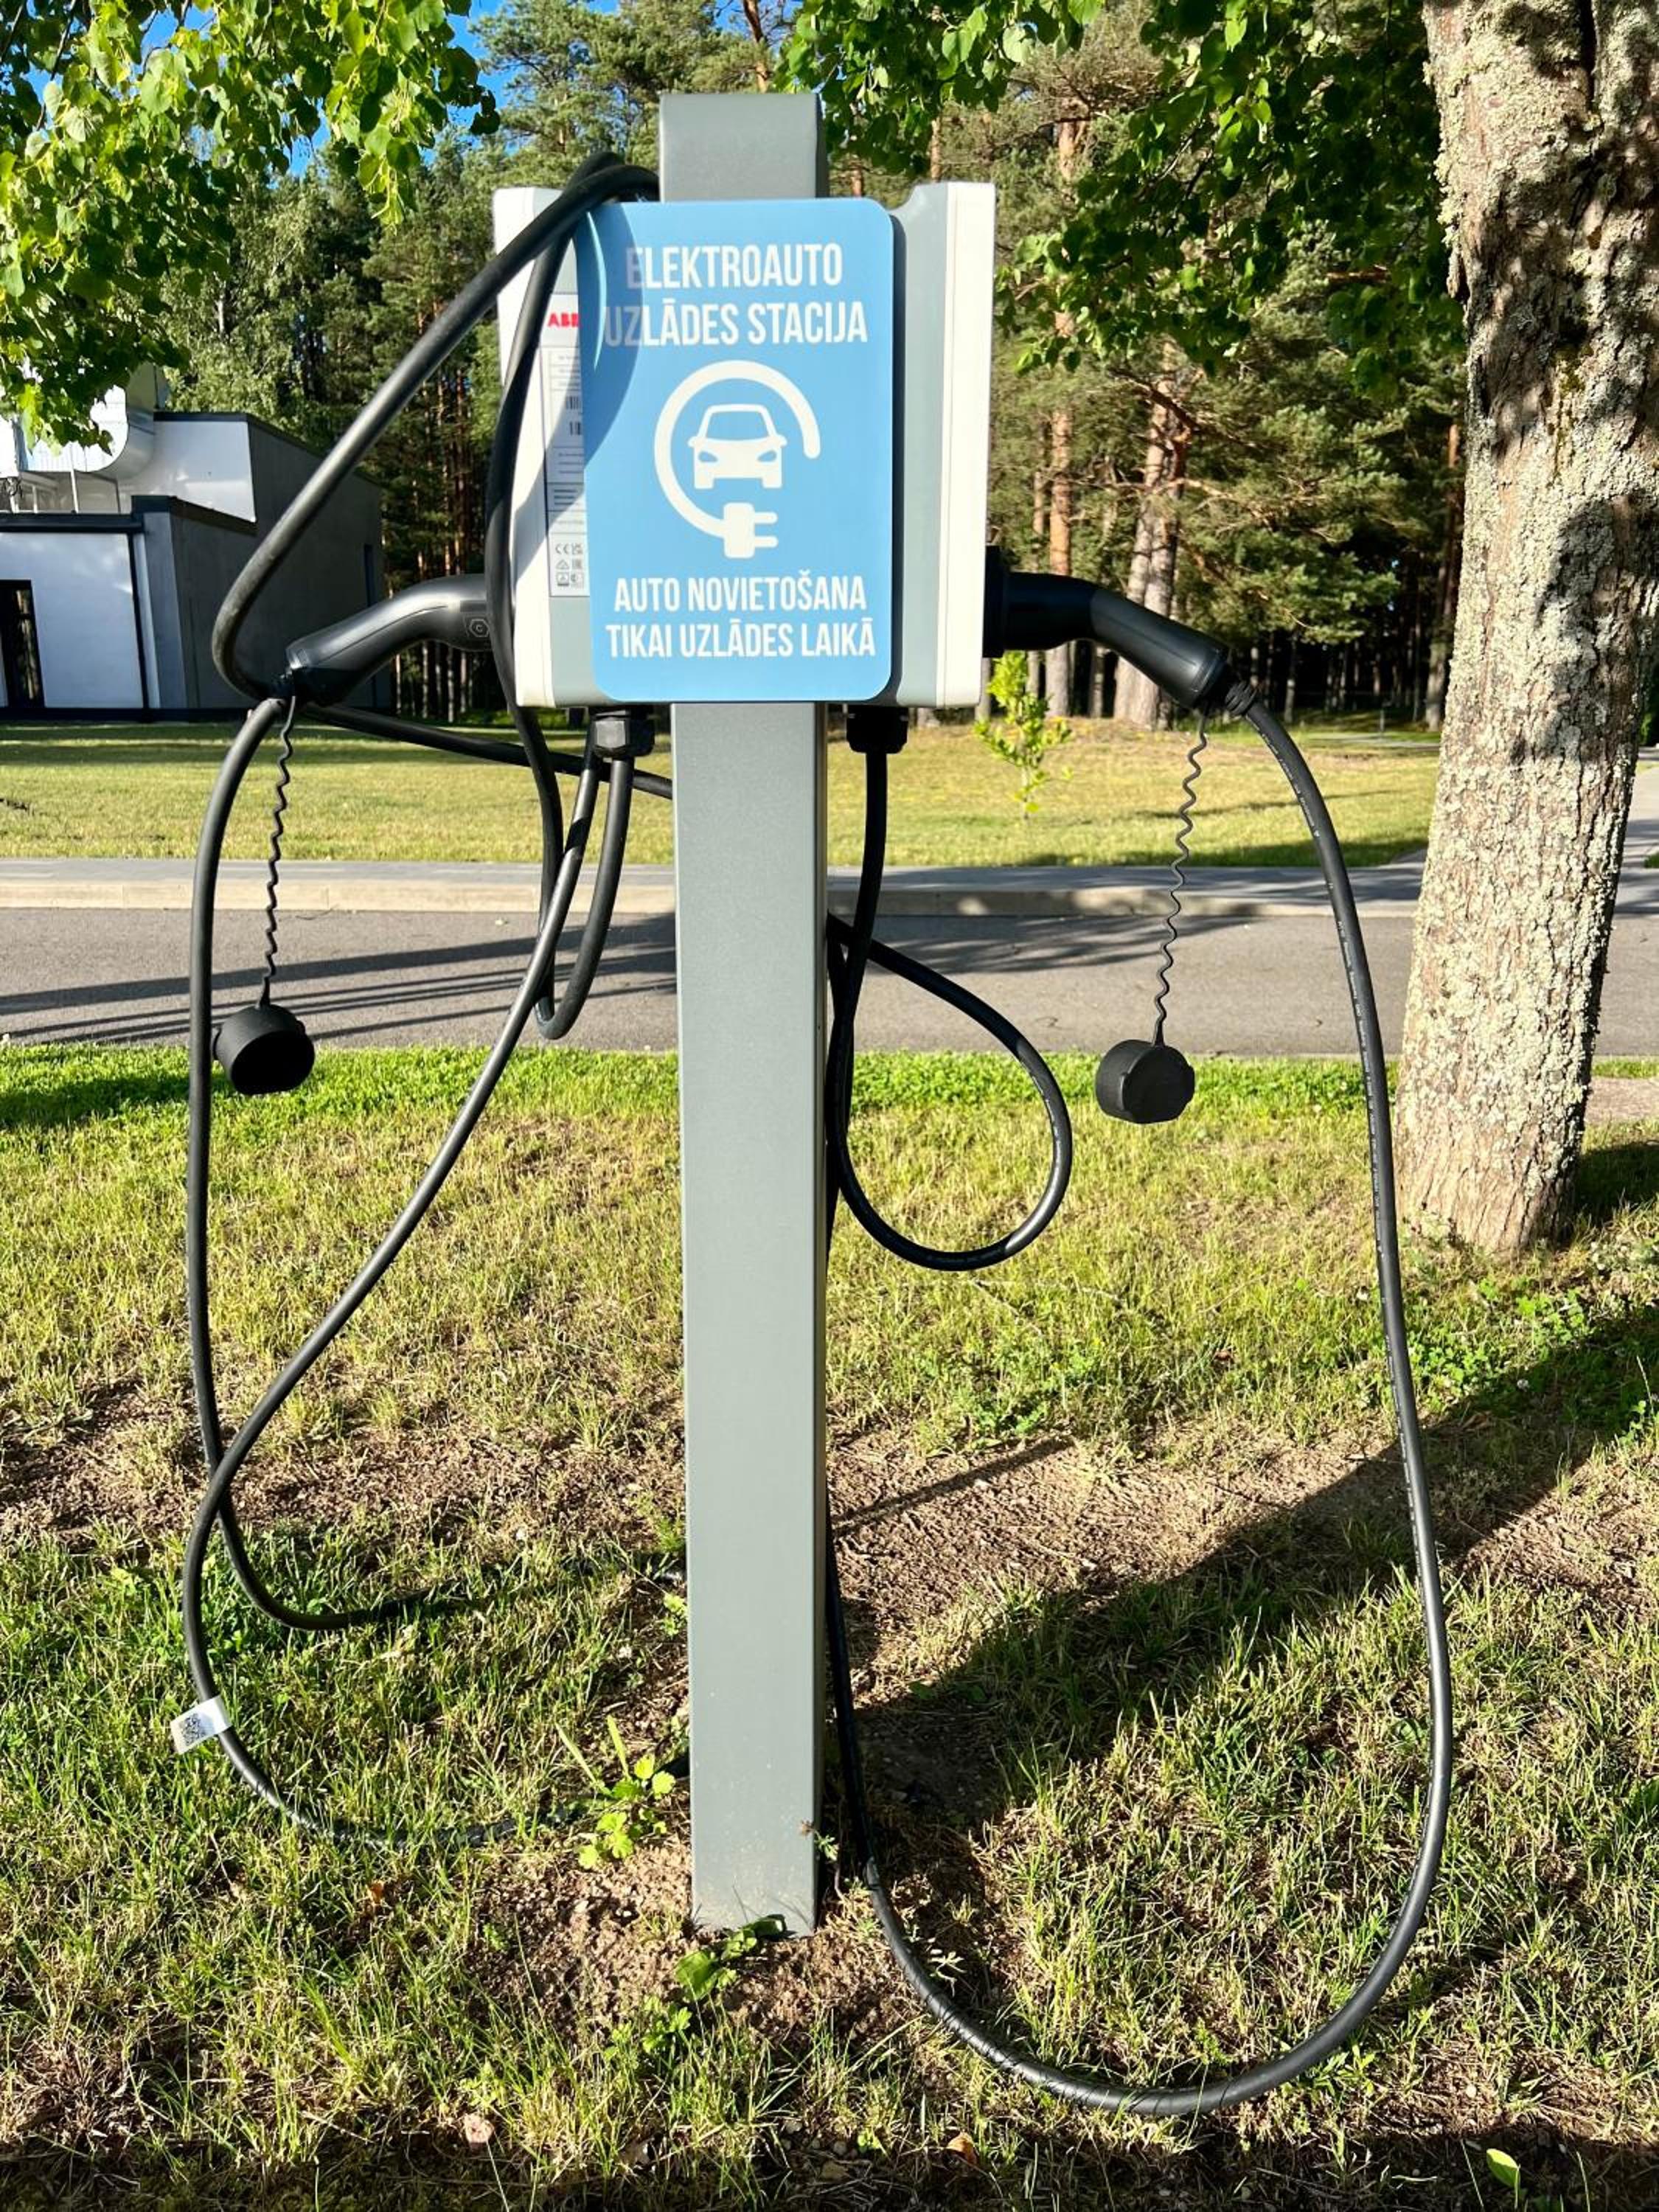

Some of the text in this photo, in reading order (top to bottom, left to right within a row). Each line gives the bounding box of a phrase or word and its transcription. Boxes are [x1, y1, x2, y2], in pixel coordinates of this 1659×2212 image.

[626, 243, 843, 289] ELEKTROAUTO
[605, 299, 868, 347] UZLĀDES STACIJA
[613, 569, 866, 612] AUTO NOVIETOŠANA
[605, 617, 876, 658] TIKAI UZLĀDES LAIKĀ
